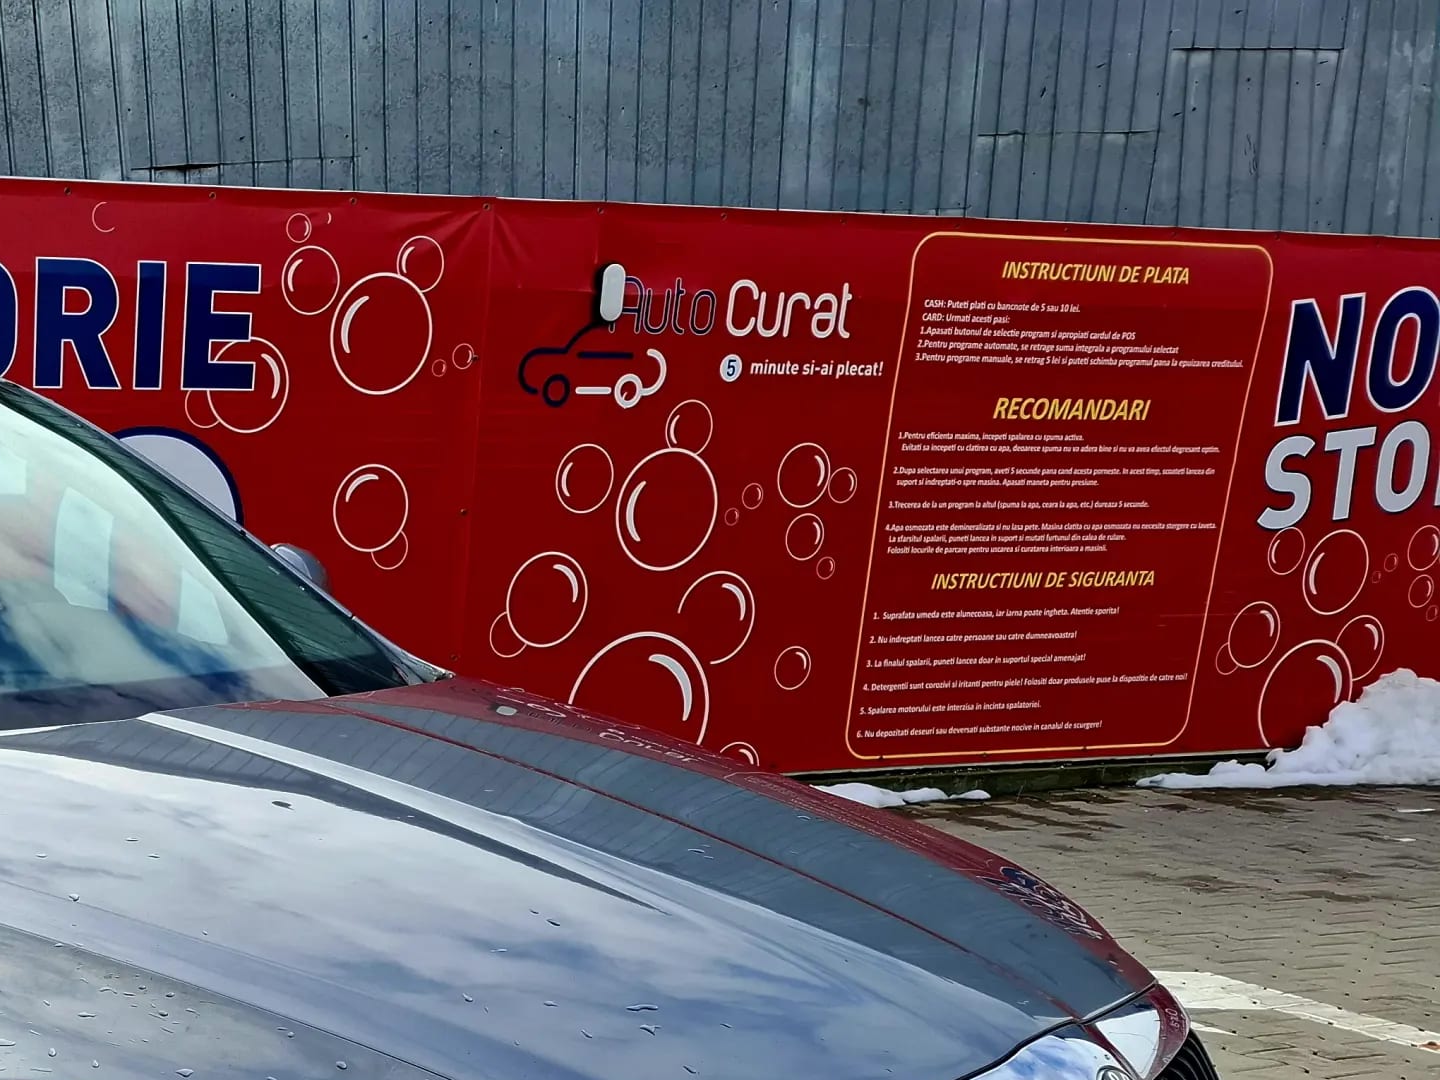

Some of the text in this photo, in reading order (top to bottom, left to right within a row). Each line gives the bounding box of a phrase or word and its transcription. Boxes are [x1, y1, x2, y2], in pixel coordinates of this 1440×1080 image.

[1002, 261, 1188, 284] INSTRUCTIUNI DE PLATA
[725, 279, 853, 339] Curat
[924, 299, 946, 307] CASH:
[947, 299, 968, 308] Puteti
[969, 300, 985, 310] plati
[996, 301, 1029, 310] bancnote
[922, 312, 1010, 324] CARD: Urmati acesti pasi:
[920, 326, 953, 336] 1.Apasati
[953, 326, 982, 335] butonul
[992, 328, 1019, 336] selectie
[1020, 330, 1049, 339] program
[1057, 330, 1089, 339] apropiati
[1089, 331, 1111, 339] cardul
[726, 358, 883, 380] 5 minute si-ai plecat!
[993, 397, 1150, 420] RECOMANDARI
[1257, 421, 1440, 530] STO
[931, 570, 1154, 589] INSTRUCTIUNI DE SIGURANTA
